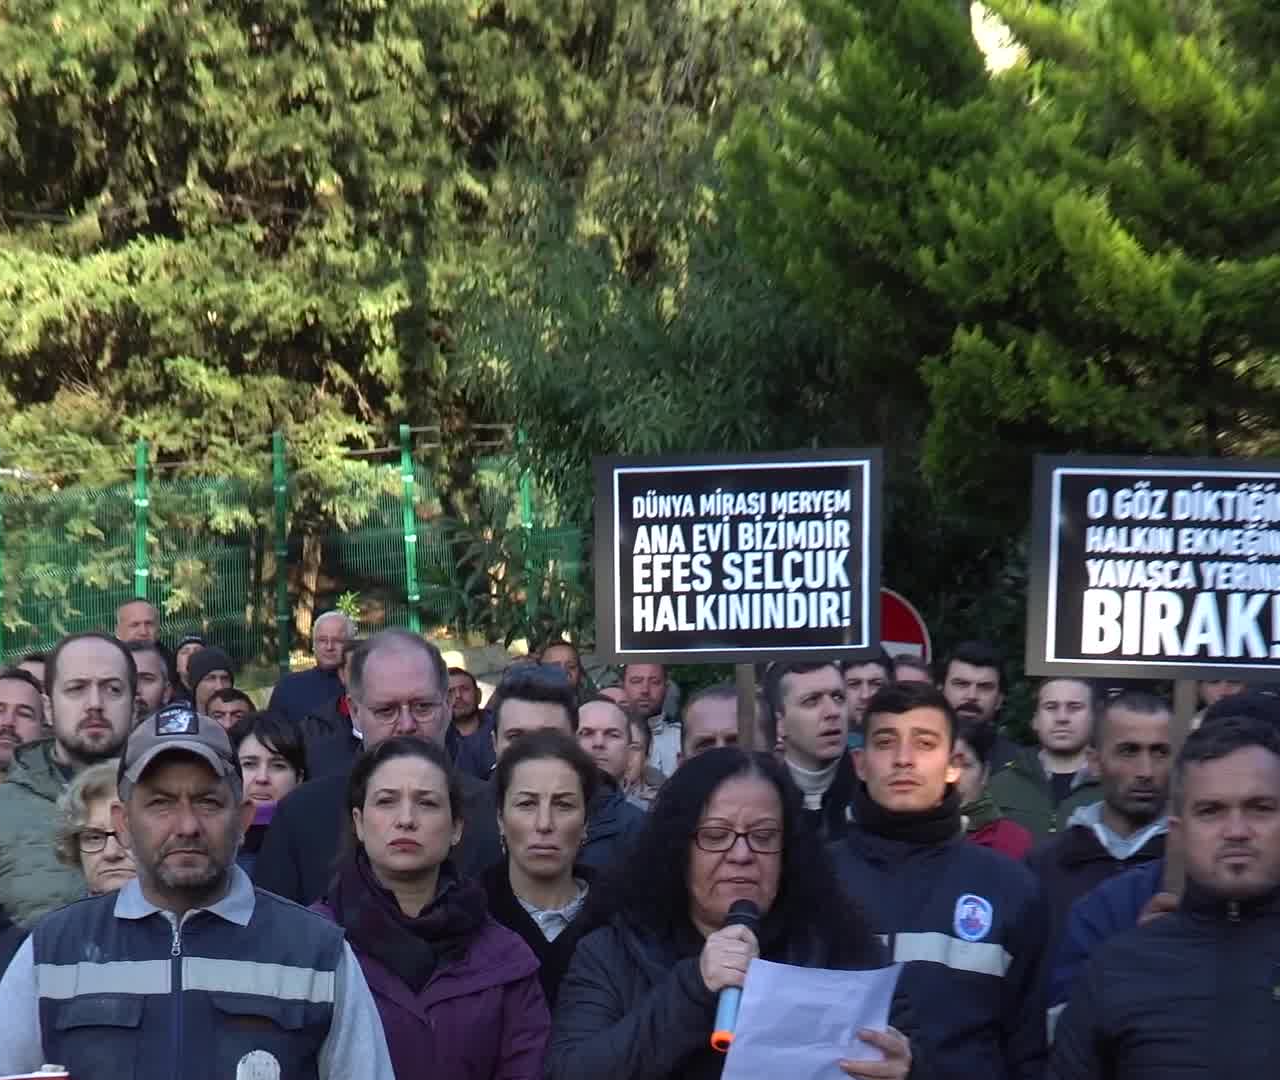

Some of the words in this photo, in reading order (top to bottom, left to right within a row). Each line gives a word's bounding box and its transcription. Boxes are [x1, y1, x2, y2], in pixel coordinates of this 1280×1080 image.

[632, 490, 695, 519] DÜNYA
[700, 488, 766, 516] MİRASI
[771, 489, 851, 514] MERYEM
[1086, 487, 1108, 519] O
[1112, 481, 1168, 520] GÖZ
[633, 524, 684, 554] ANA
[692, 516, 731, 552] EVİ
[738, 511, 850, 551] BİZİMDİR
[1086, 526, 1174, 554] HALKIN
[632, 553, 713, 593] EFES
[722, 550, 850, 594] SELÇUK
[632, 591, 851, 632] HALKININDIR!
